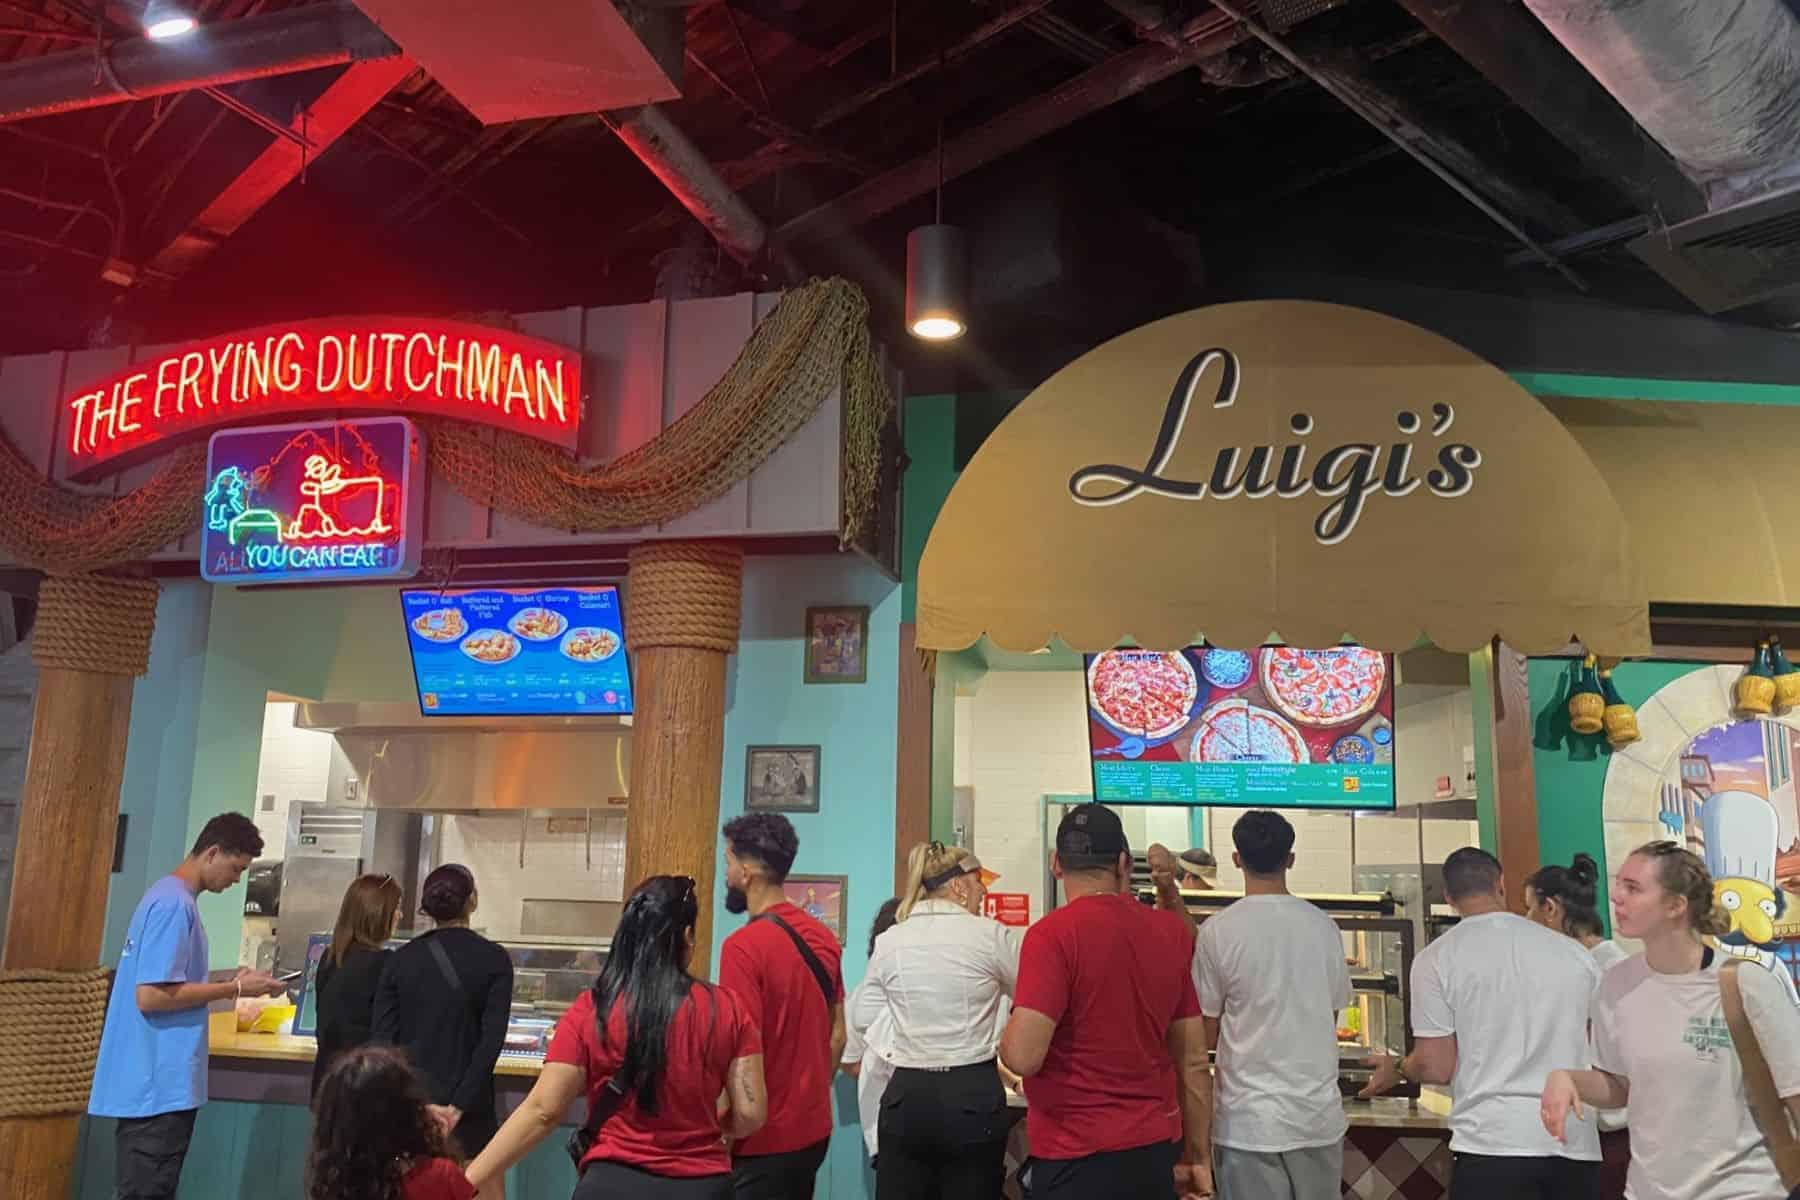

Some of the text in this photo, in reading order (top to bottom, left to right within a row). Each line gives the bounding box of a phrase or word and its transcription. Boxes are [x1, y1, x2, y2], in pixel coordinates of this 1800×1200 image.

[71, 332, 567, 454] THE FRYING DUTCHMAN
[1068, 346, 1482, 546] Luigi's
[246, 543, 289, 568] YOU
[289, 545, 336, 568] CAN
[340, 543, 385, 567] EAT
